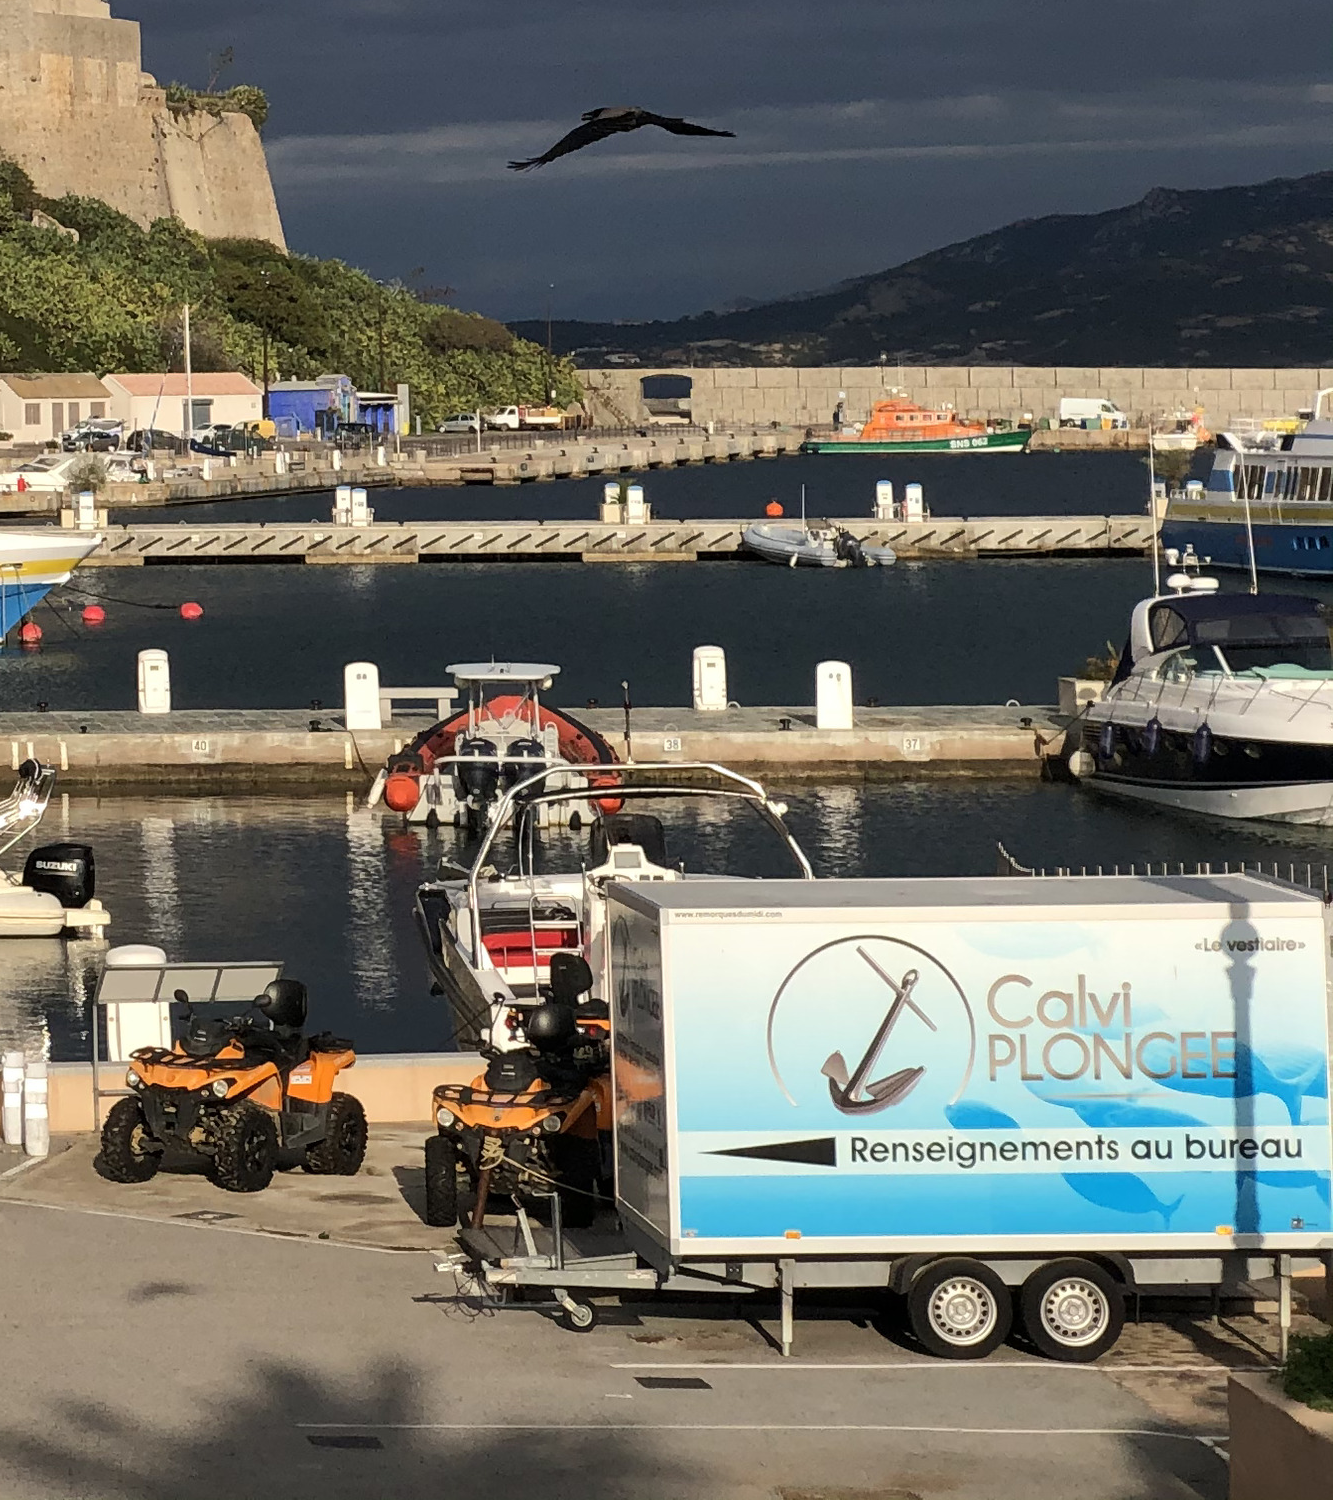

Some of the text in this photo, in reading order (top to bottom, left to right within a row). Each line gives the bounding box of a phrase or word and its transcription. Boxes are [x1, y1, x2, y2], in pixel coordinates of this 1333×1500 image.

[194, 740, 207, 751] 40
[666, 739, 680, 750] 38
[905, 739, 918, 750] 37
[35, 860, 78, 872] SUZUKI
[674, 910, 783, 920] www.remorquesdumidi.com
[986, 973, 1132, 1029] Calvi
[988, 1031, 1238, 1082] PLONGEE
[850, 1133, 1303, 1168] Renseignements au bureau
